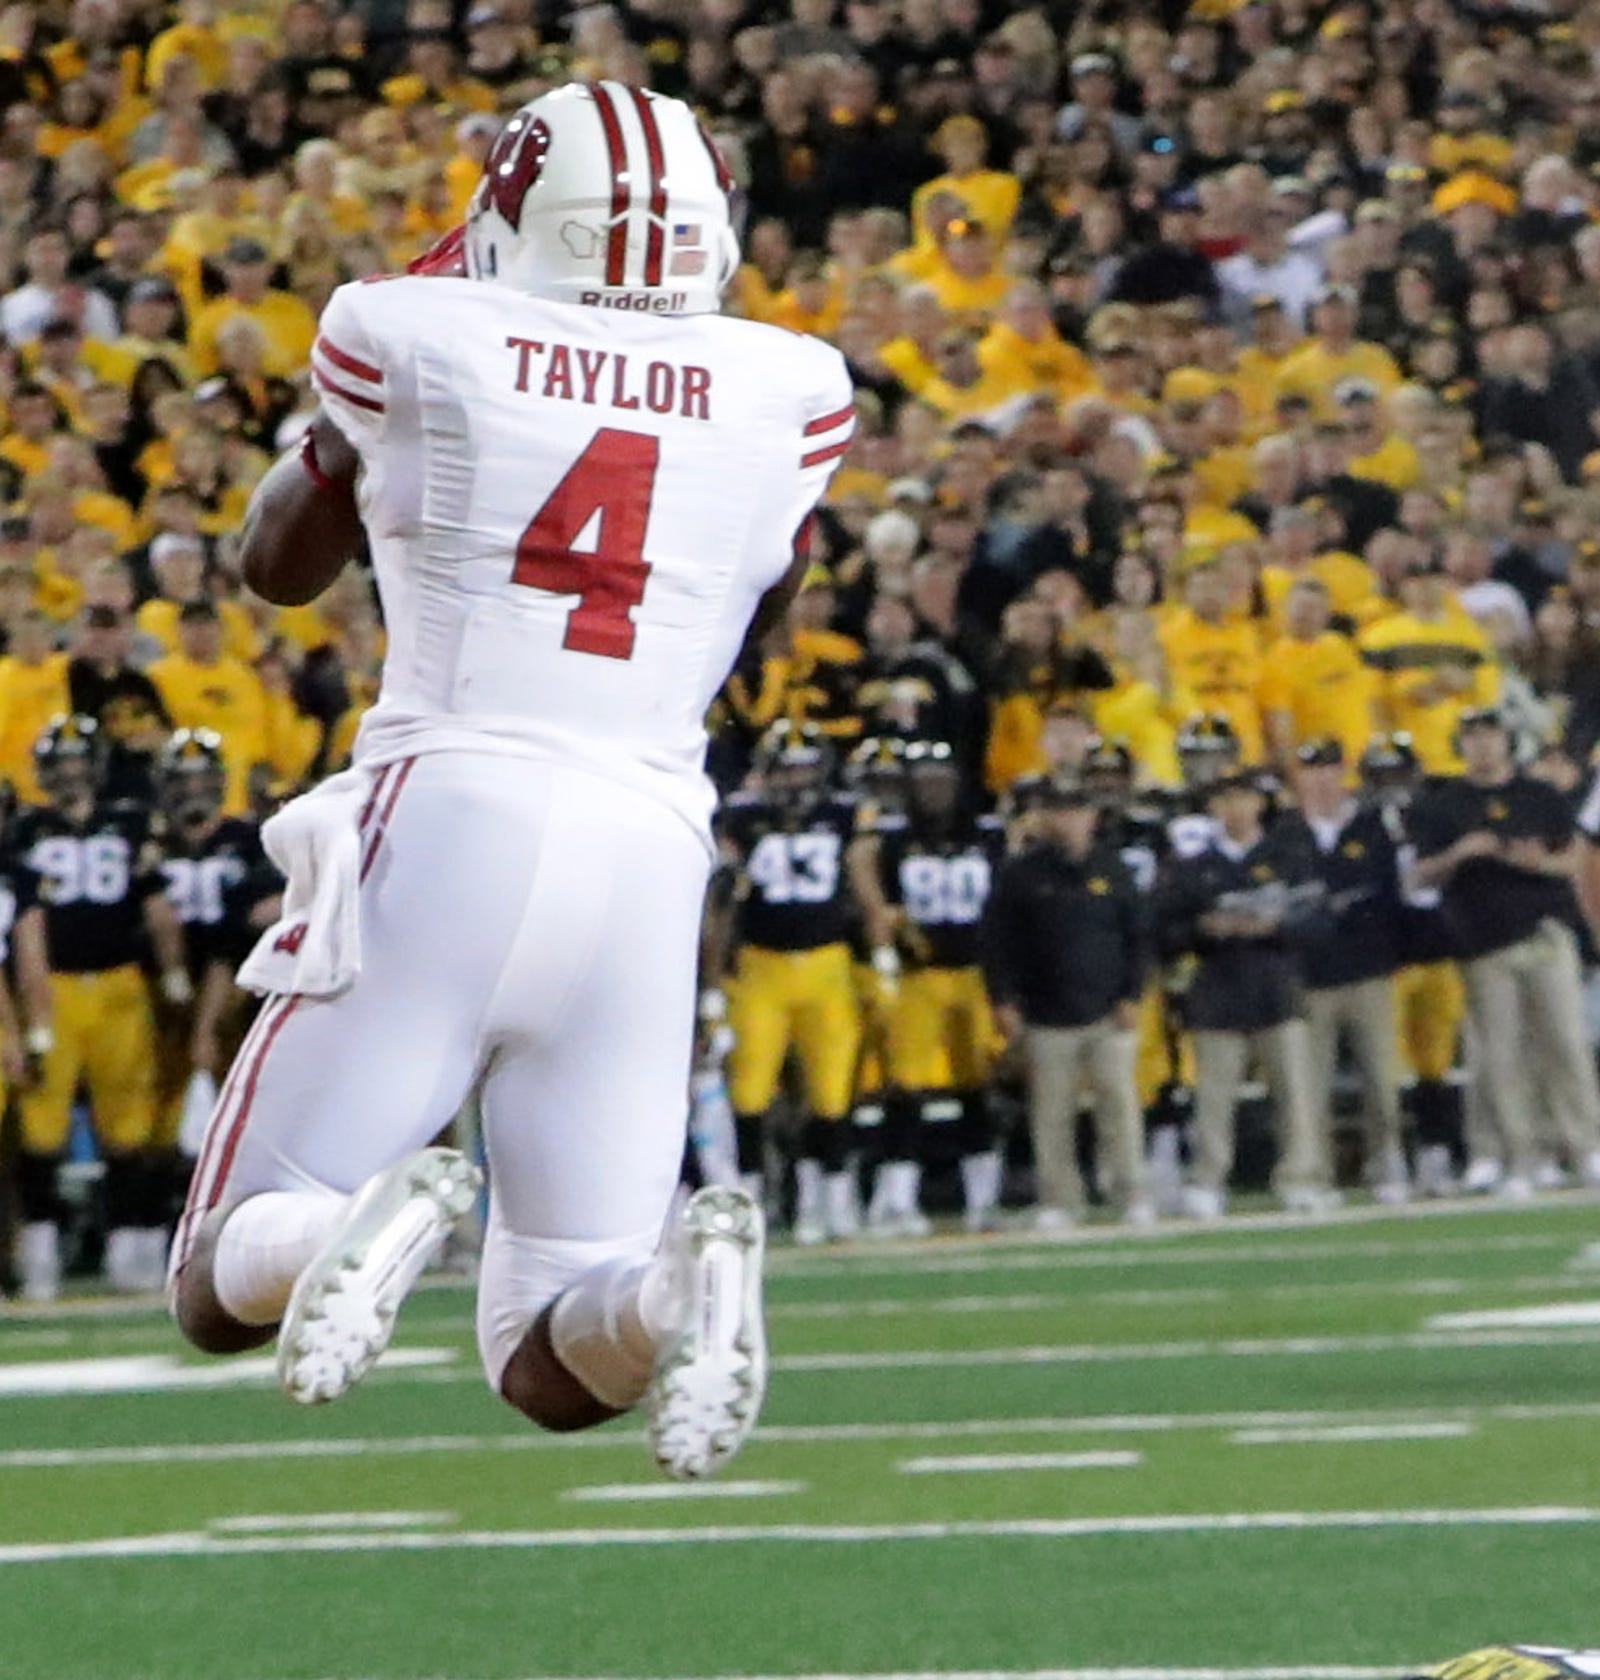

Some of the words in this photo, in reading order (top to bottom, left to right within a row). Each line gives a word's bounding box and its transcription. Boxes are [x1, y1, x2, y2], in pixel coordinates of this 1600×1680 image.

[580, 291, 687, 311] Riddell
[506, 336, 711, 421] TAYLOR
[511, 427, 659, 660] 4
[28, 834, 130, 905] 96
[748, 831, 841, 903] 43
